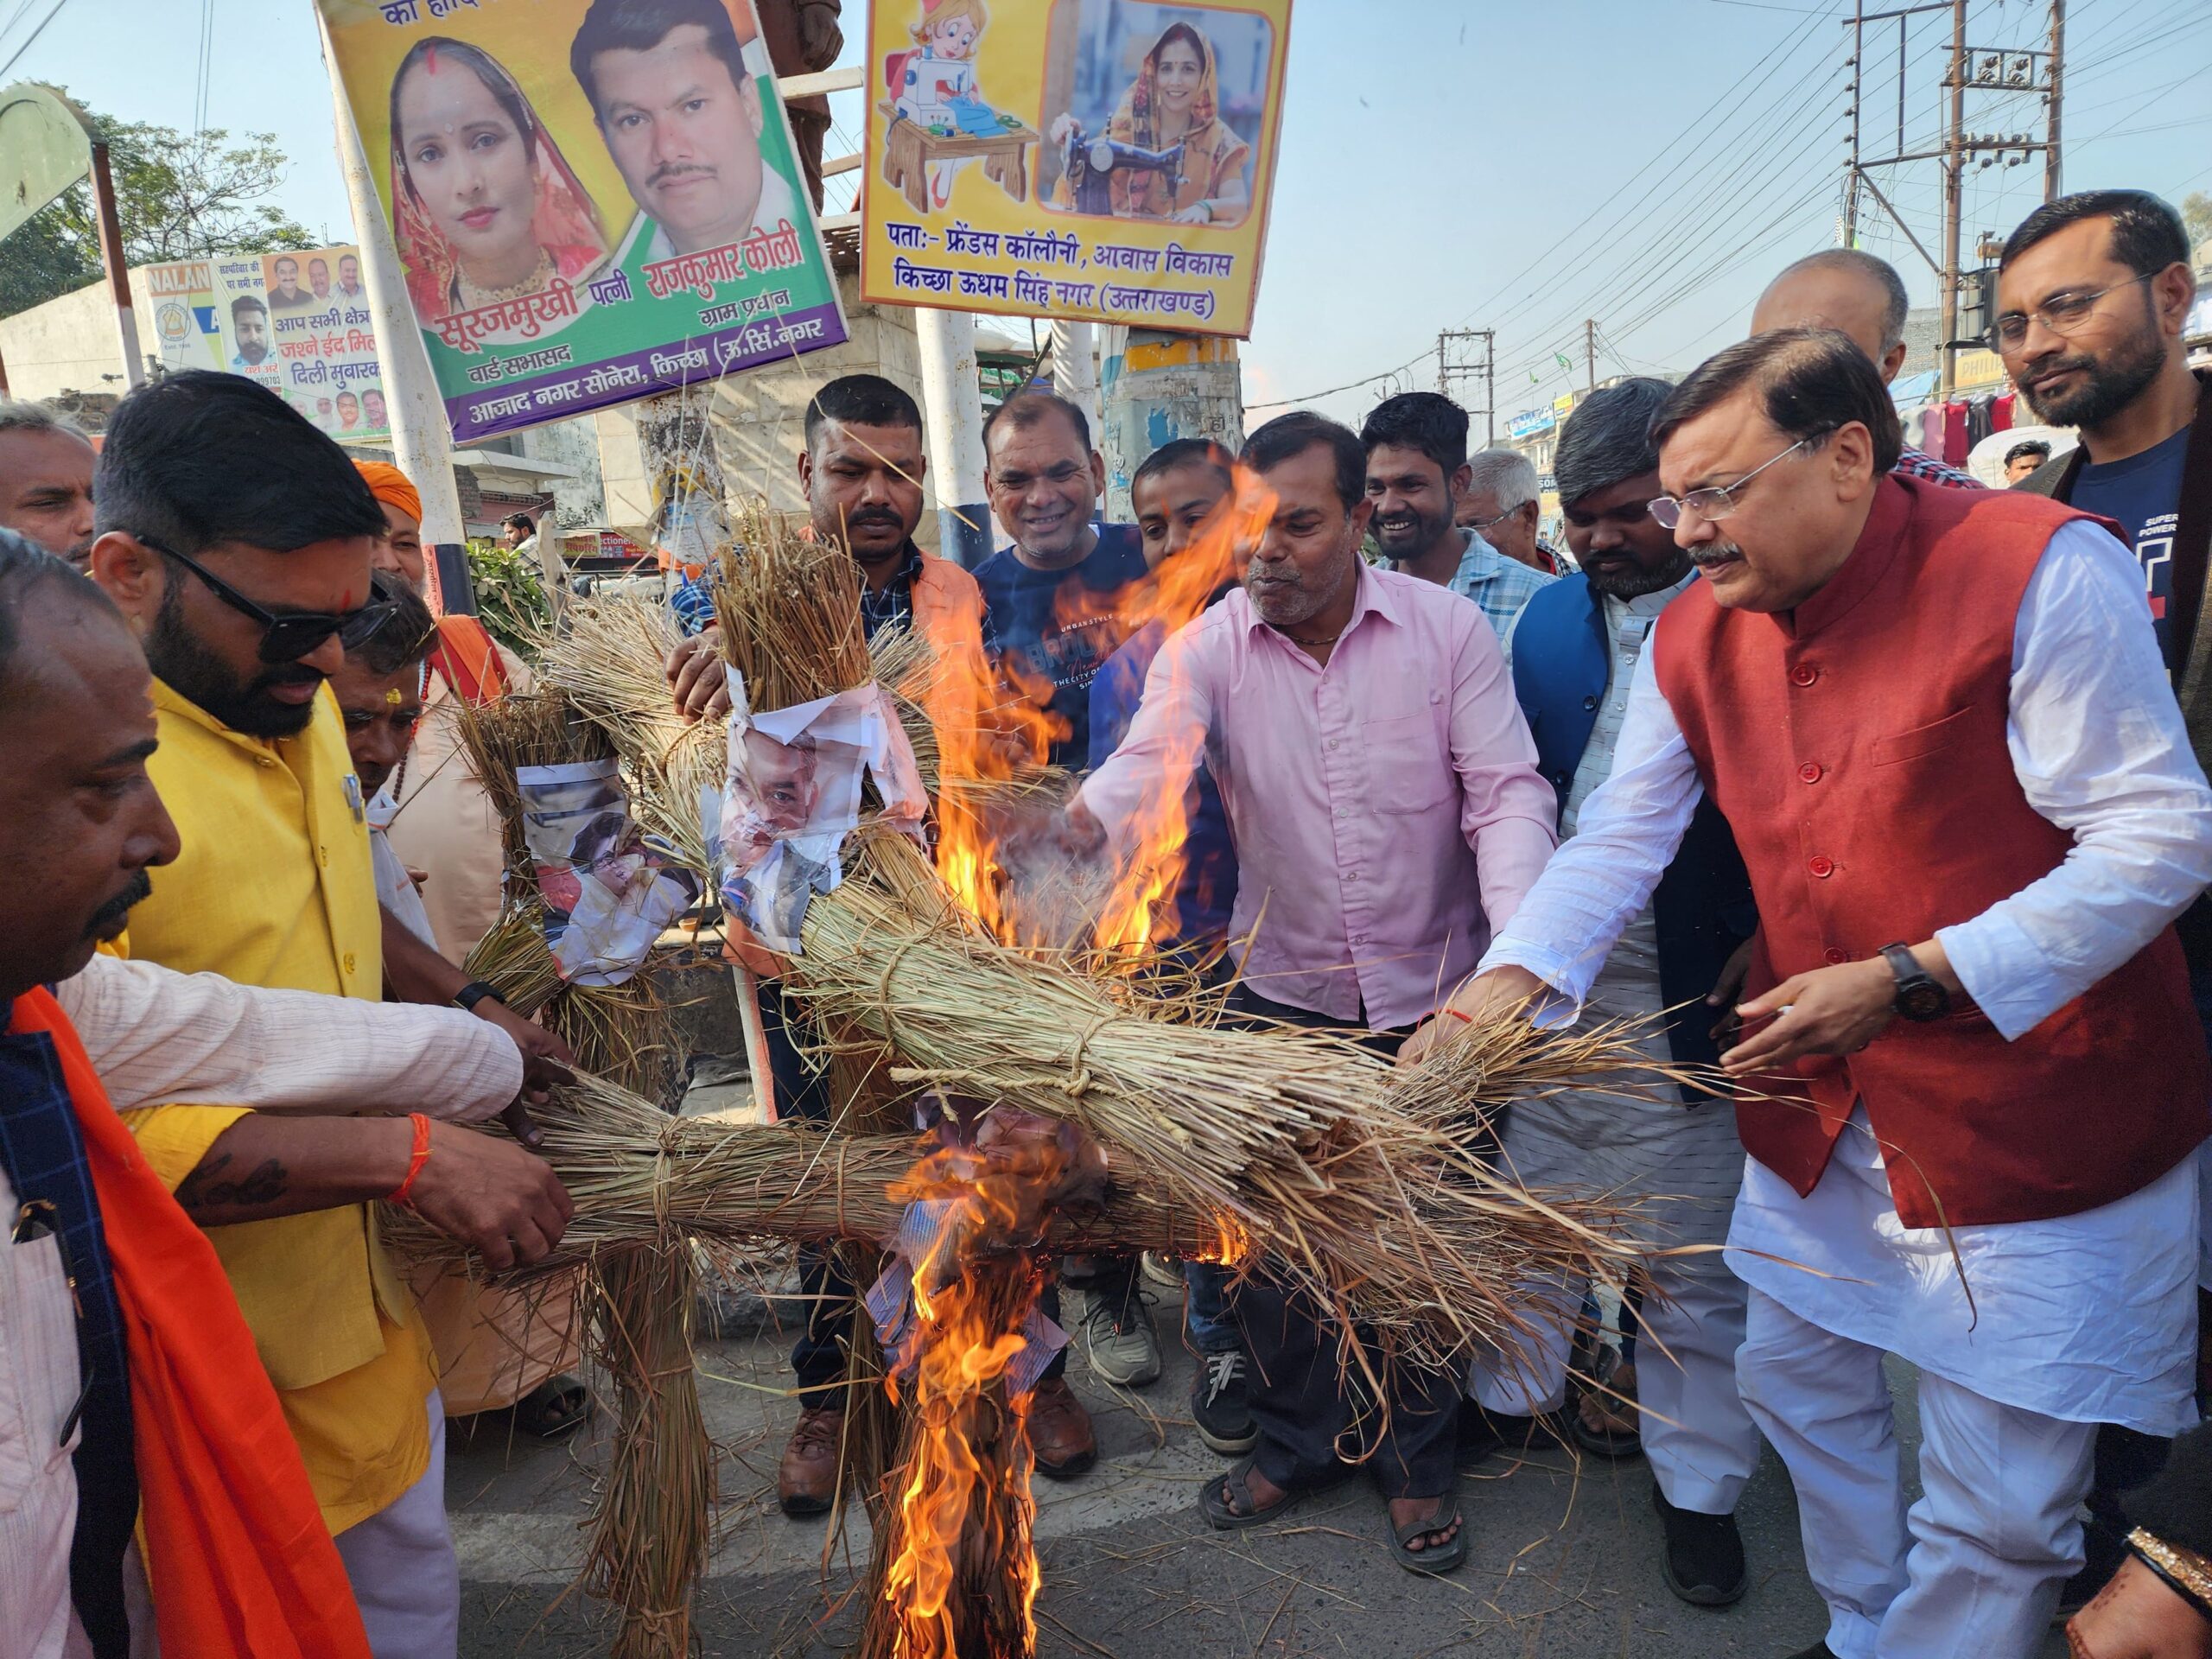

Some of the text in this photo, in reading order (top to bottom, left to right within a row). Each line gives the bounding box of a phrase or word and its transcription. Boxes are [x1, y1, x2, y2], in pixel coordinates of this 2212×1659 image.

[1093, 245, 1160, 272] आवास
[1165, 243, 1234, 276] विकास
[252, 278, 265, 288] नग
[434, 219, 803, 353] सूरजमुखी पत्नी राजकुमार कोली
[893, 257, 953, 291] किच्छा
[957, 271, 1009, 298] ऊधम
[1055, 282, 1095, 307] नगर
[1099, 283, 1215, 320] (उत्तराखण्ड)
[276, 316, 306, 332] आप
[308, 308, 341, 329] सभी
[698, 289, 791, 327] ग्राम प्रधान
[279, 334, 319, 358] जश्ने
[321, 331, 346, 357] ईद
[290, 359, 327, 385] दिली
[467, 345, 571, 383] वार्ड सभासद
[469, 391, 531, 423] आजाद
[534, 377, 582, 406] नगर
[584, 364, 647, 394] सोनेरा,
[650, 348, 709, 379] किच्छा
[2139, 524, 2177, 537] POWER
[2145, 513, 2178, 526] SUPER
[1061, 613, 1113, 632] URBAN STYLE
[1053, 677, 1071, 688] THE
[1071, 672, 1089, 683] CITY
